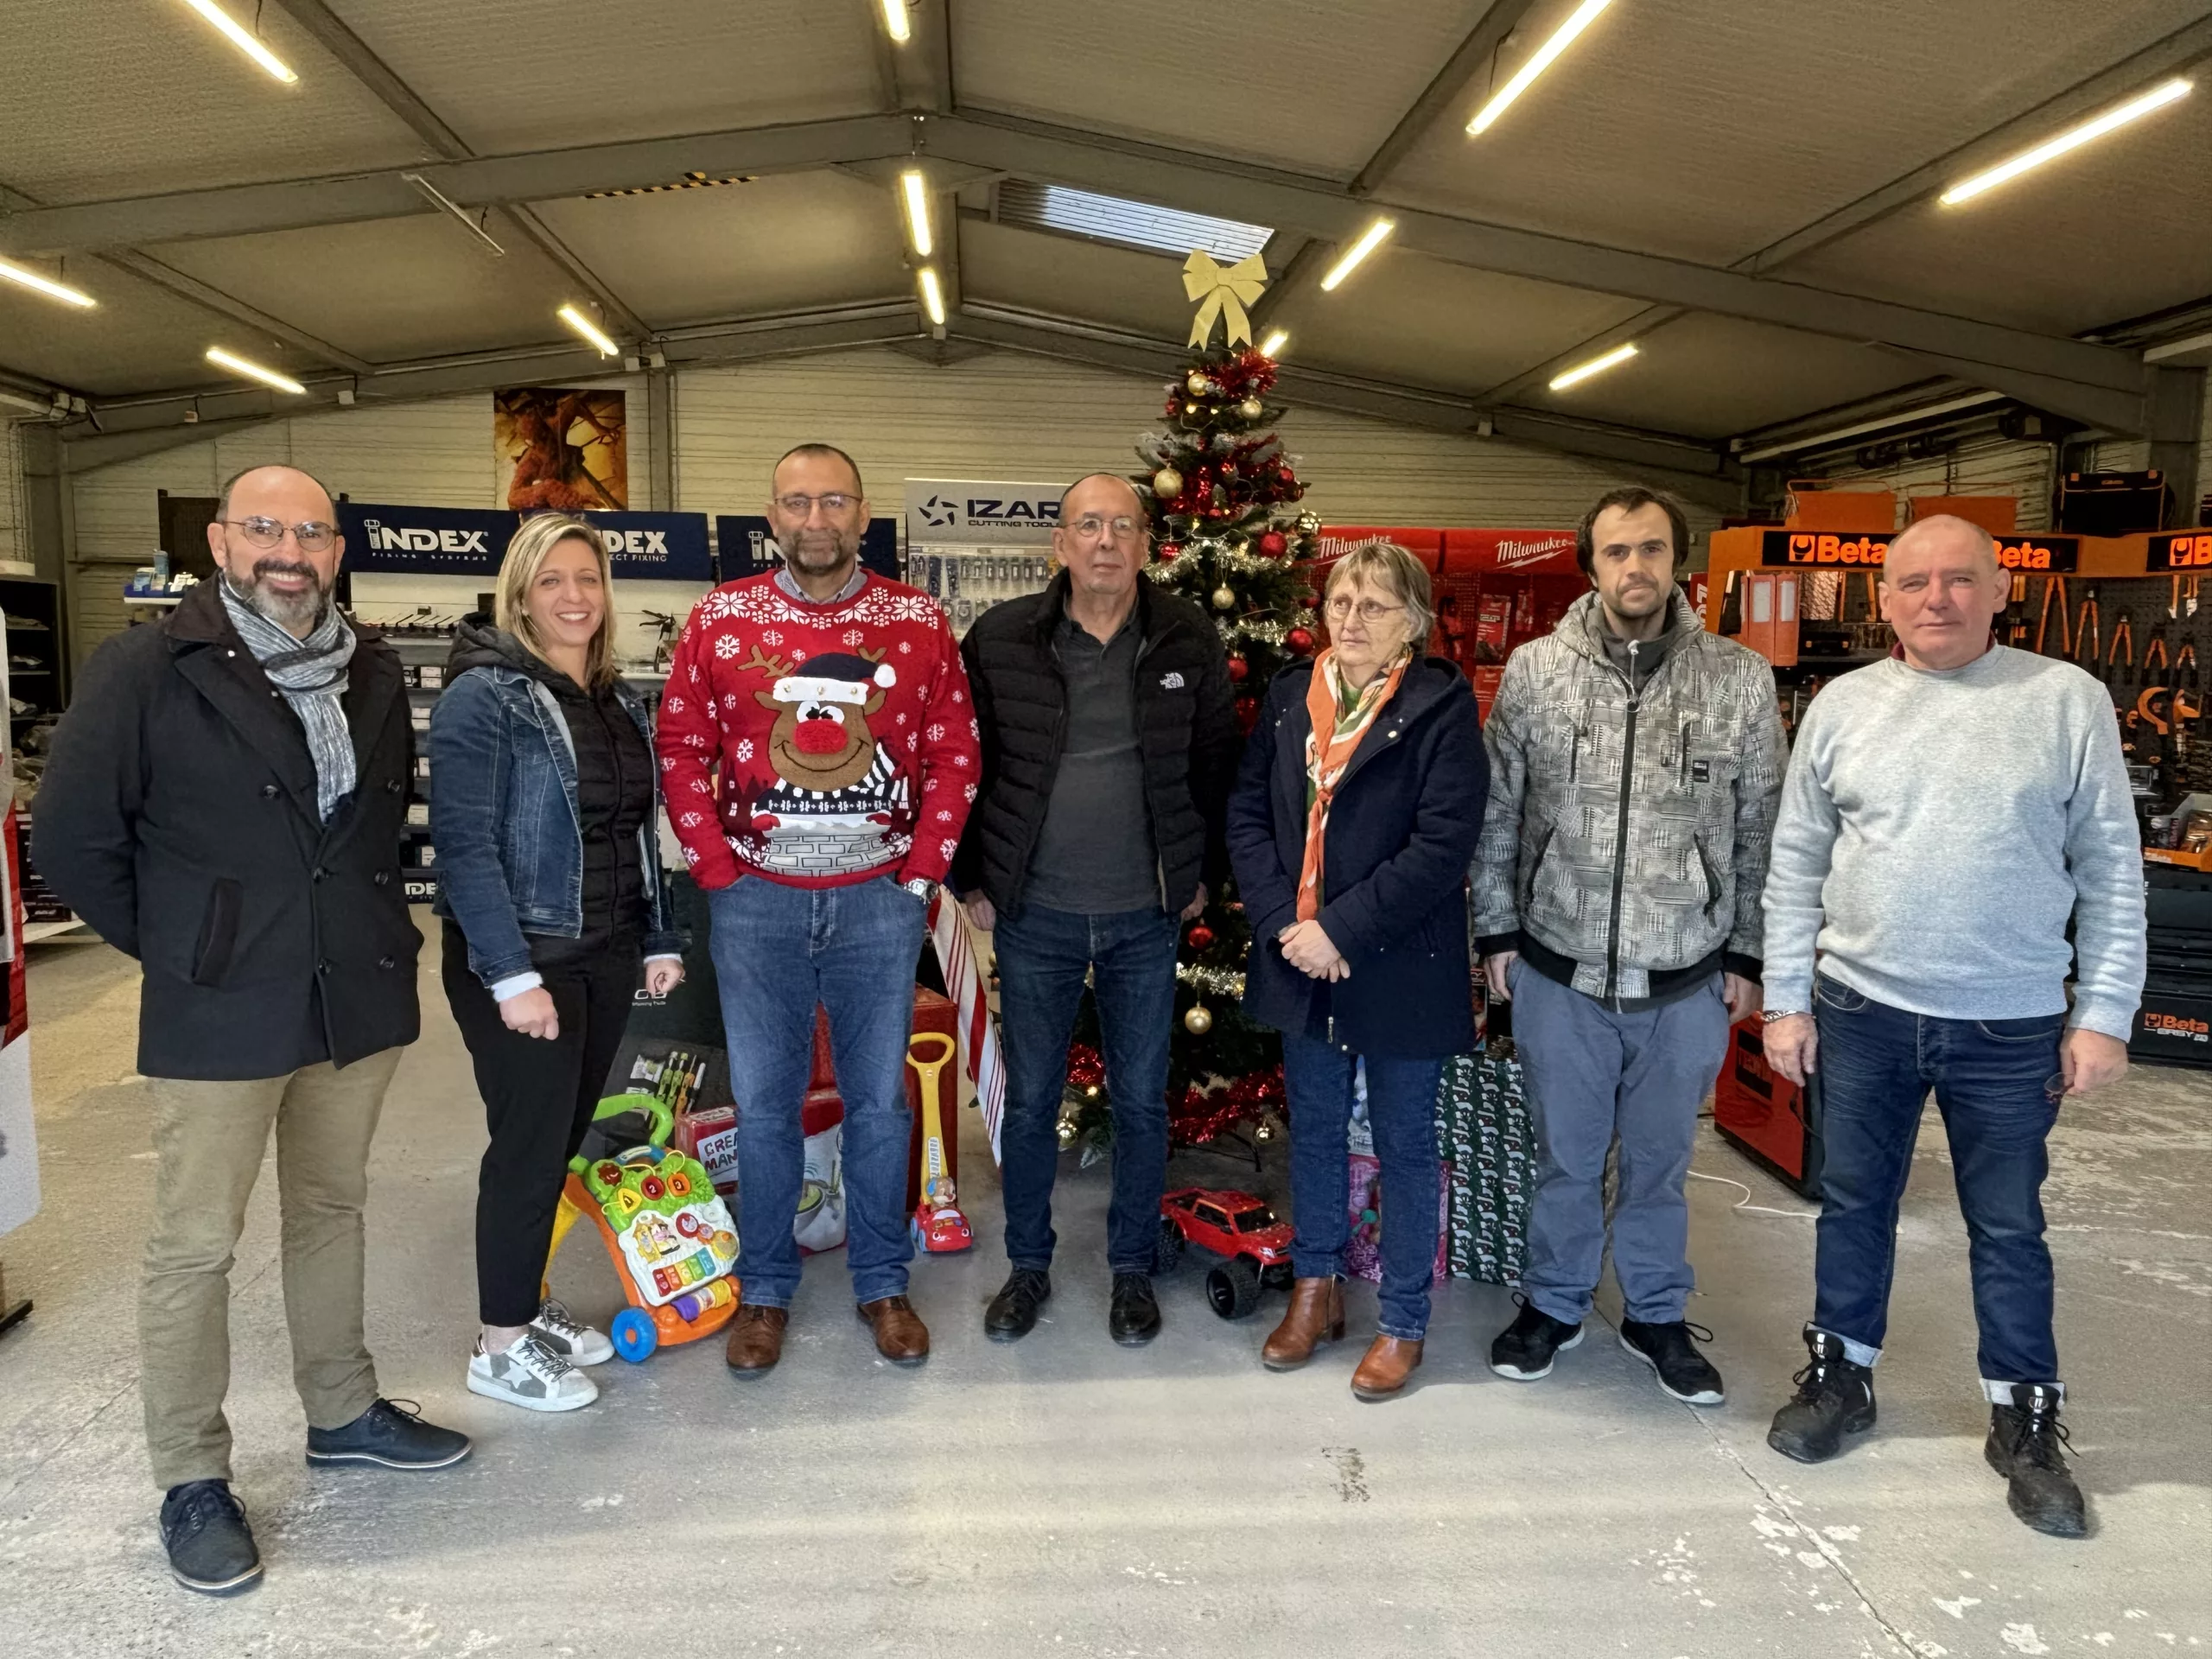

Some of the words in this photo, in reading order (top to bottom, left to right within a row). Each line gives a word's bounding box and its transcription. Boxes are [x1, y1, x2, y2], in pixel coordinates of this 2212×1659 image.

[967, 499, 1061, 519] IZAR
[968, 519, 1021, 528] CUTTING
[594, 530, 669, 554] DEX
[1319, 532, 1392, 559] Milwaukee
[1494, 537, 1576, 563] Milwaukee
[1817, 535, 1890, 564] Beta
[632, 554, 667, 563] FIXING
[2162, 1014, 2209, 1033] Beta
[648, 1184, 657, 1194] 2
[675, 1179, 683, 1190] 3
